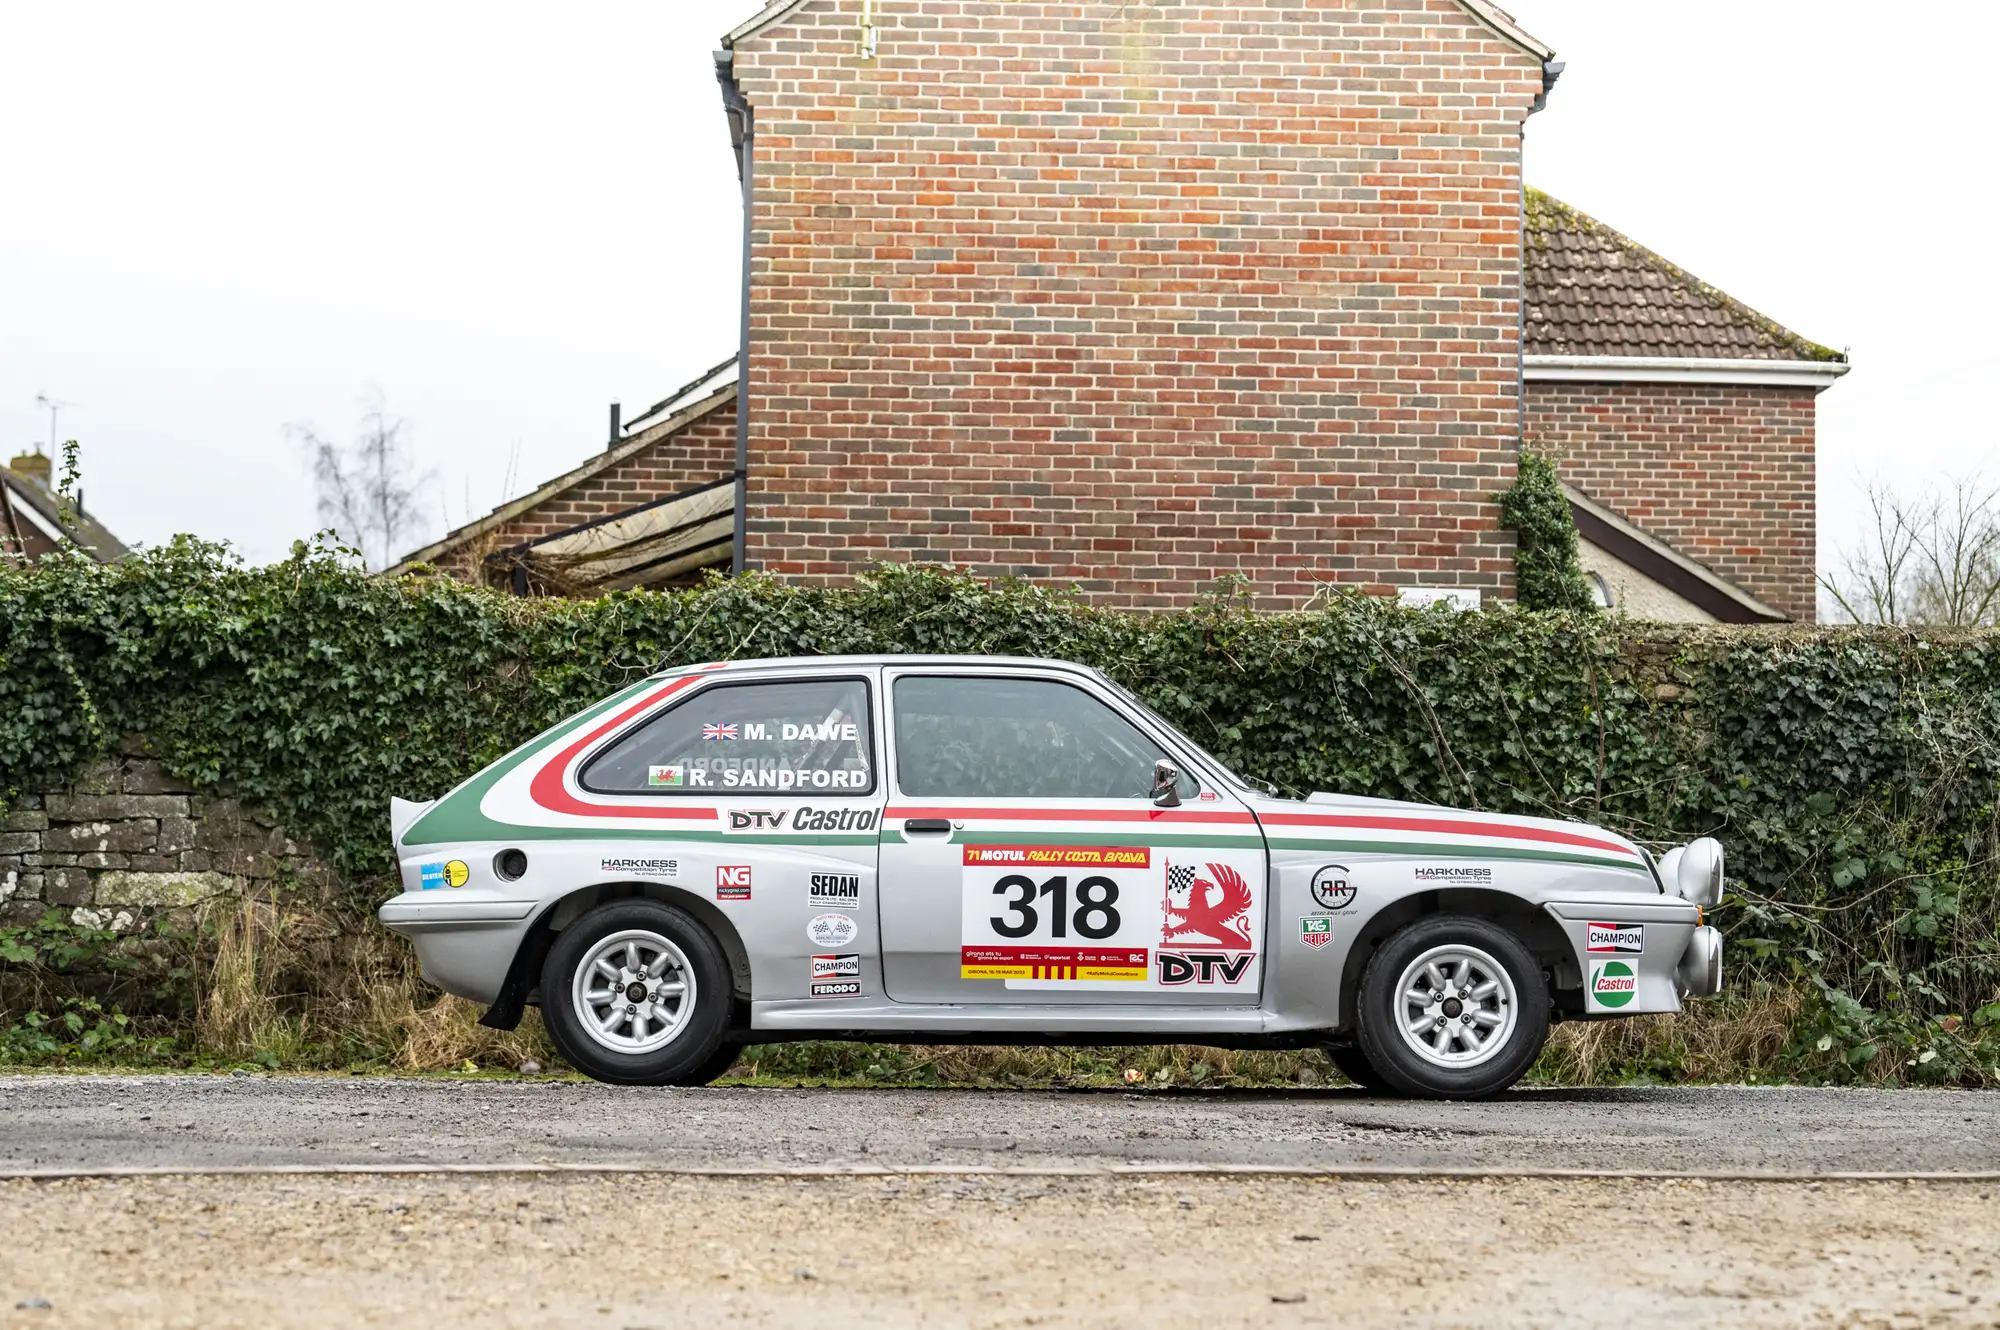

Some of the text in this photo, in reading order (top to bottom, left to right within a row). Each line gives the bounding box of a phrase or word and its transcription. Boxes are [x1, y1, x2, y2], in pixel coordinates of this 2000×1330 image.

[744, 724, 858, 741] M. DAWE
[690, 769, 867, 788] R. SANDFORD
[729, 806, 880, 831] DTV Castrol
[602, 858, 677, 868] HARKNESS
[980, 850, 1026, 861] MOTUL
[1026, 850, 1062, 862] RALLY
[1064, 851, 1102, 862] COSTA
[1104, 852, 1146, 864] BRAVA
[718, 868, 750, 886] NG
[1415, 868, 1491, 876] HARKNESS
[811, 875, 859, 897] SEDAN
[990, 874, 1121, 940] 318
[1306, 920, 1326, 931] TAG
[1304, 934, 1329, 946] HEUER
[1590, 932, 1641, 944] CHAMPION
[814, 962, 857, 971] CHAMPION
[1158, 953, 1254, 984] DTV
[814, 984, 857, 994] FERODO
[1597, 978, 1635, 990] Castrol
